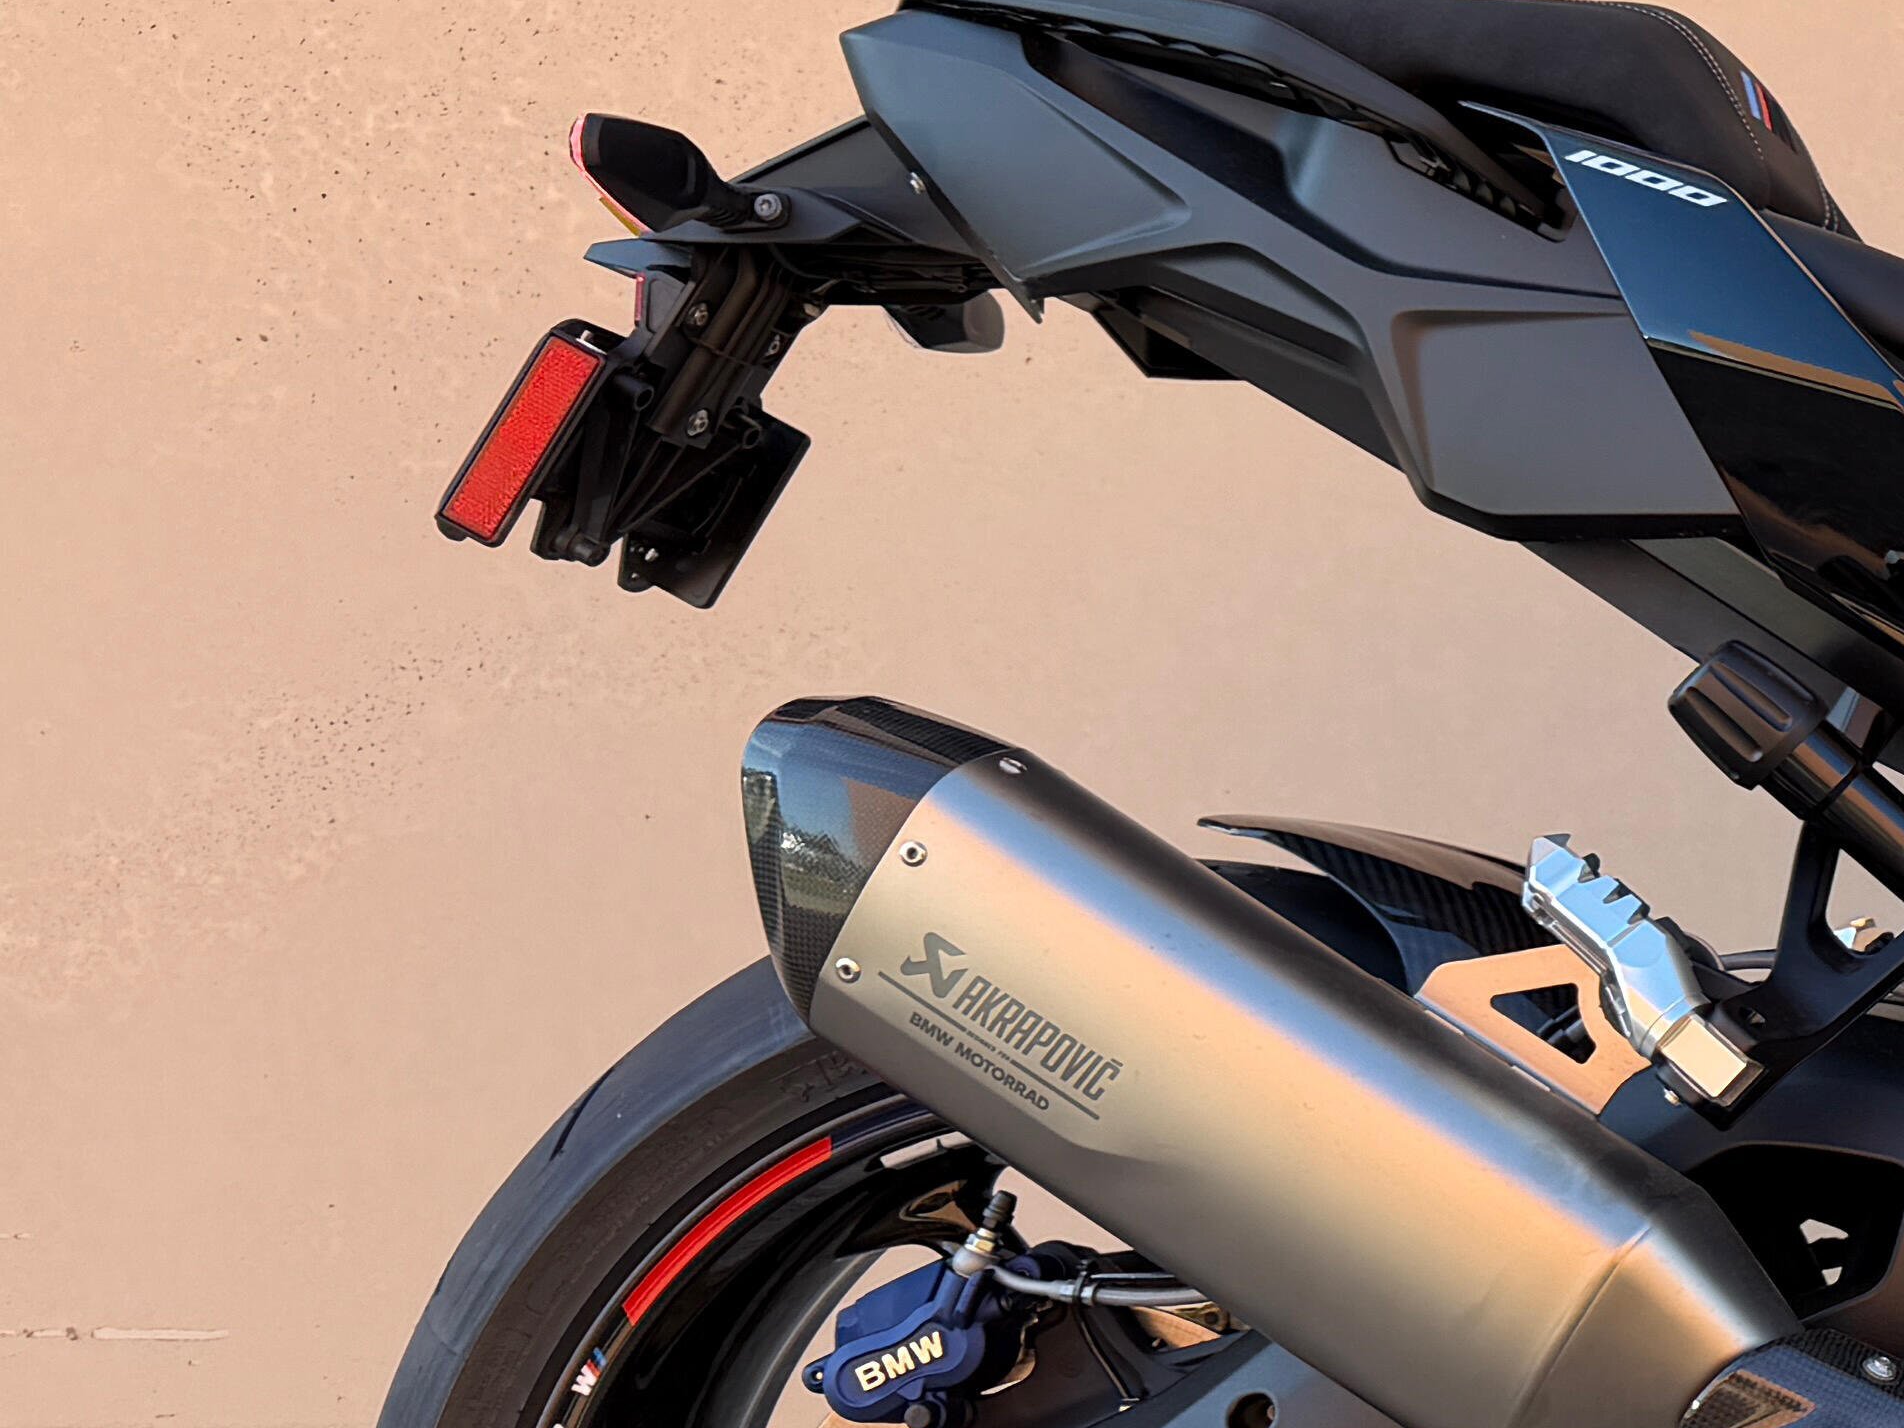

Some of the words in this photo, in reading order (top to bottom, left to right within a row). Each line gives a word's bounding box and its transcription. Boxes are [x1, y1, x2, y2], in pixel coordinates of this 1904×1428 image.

[1564, 149, 1728, 207] 1000
[909, 1011, 955, 1047] BMW
[954, 1041, 1050, 1112] MOTORRAD
[854, 1330, 945, 1392] BMW
